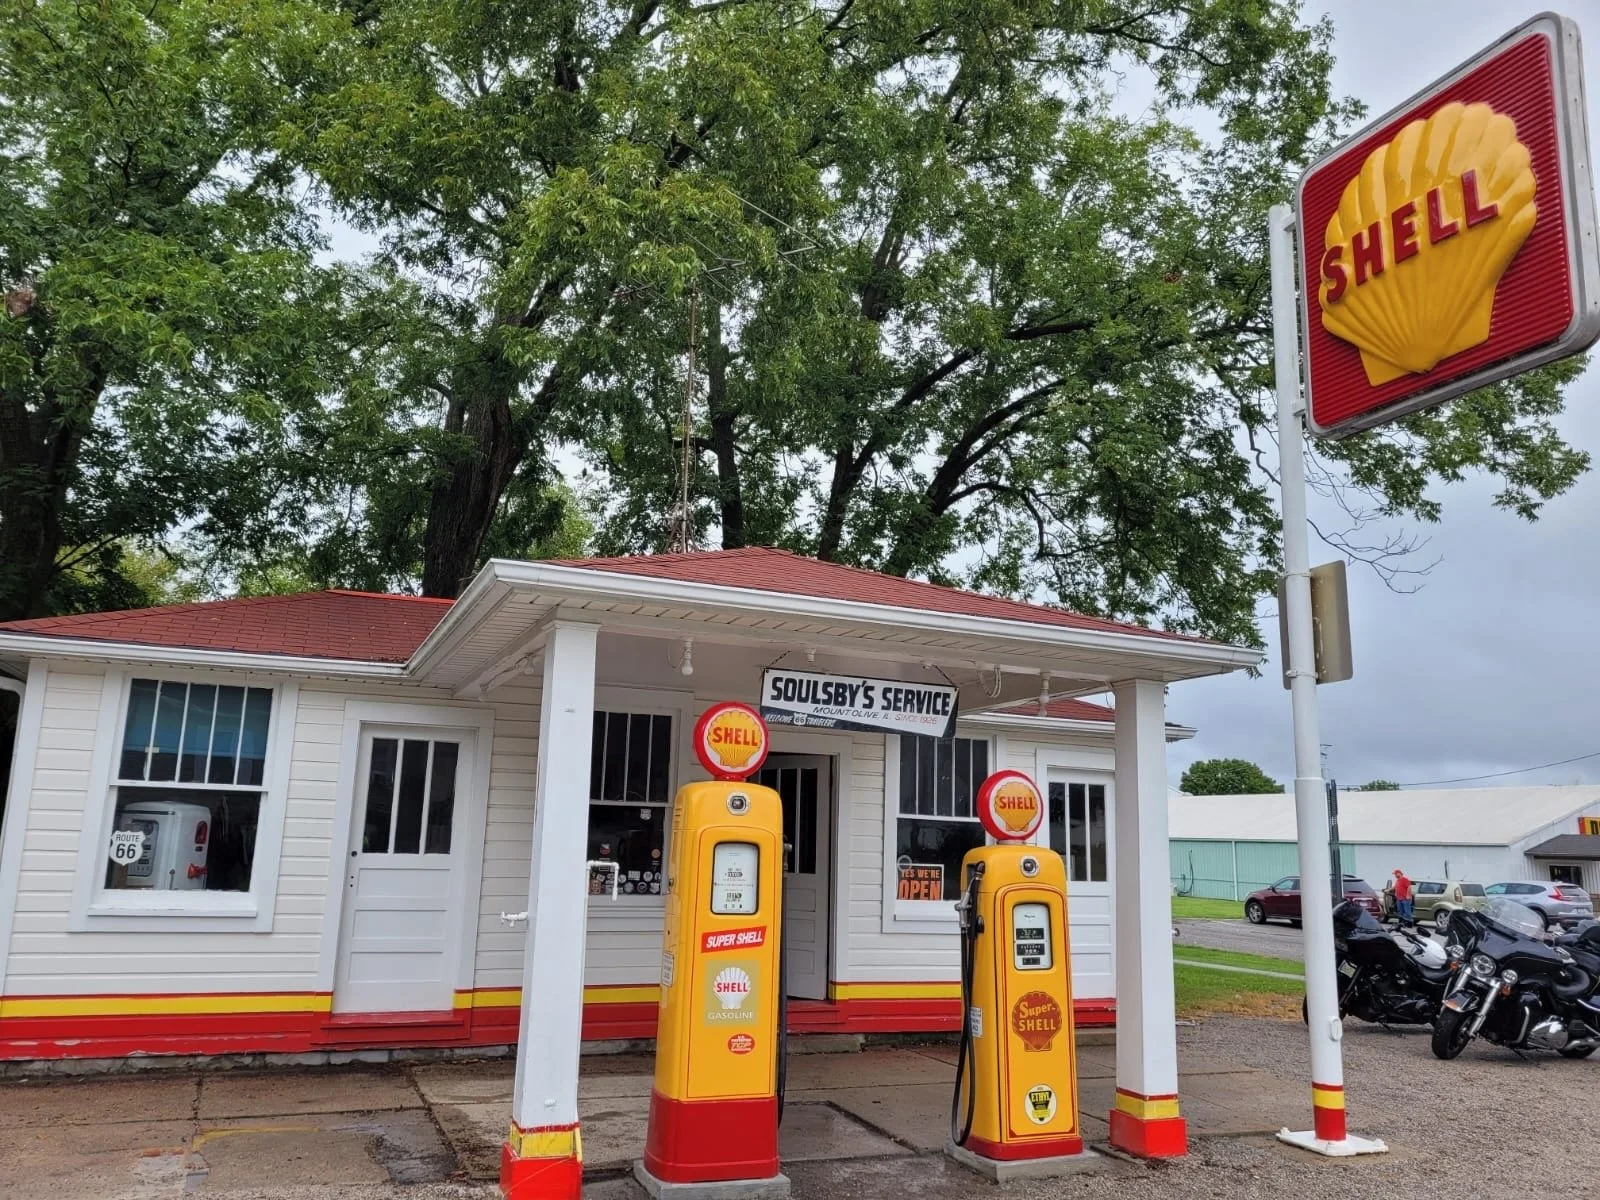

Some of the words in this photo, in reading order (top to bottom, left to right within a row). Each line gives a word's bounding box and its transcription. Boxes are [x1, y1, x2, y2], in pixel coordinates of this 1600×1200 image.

[1322, 168, 1499, 303] SHELL
[770, 676, 875, 709] SOULSBY'S
[881, 687, 950, 716] SERVICE
[812, 706, 852, 716] MOUNT
[895, 713, 917, 722] SINCE
[712, 726, 758, 747] SHELL
[999, 796, 1035, 811] SHELL
[116, 834, 140, 842] ROUTE
[116, 844, 136, 859] 66
[902, 869, 914, 878] YES
[918, 869, 940, 878] WE'RE
[898, 880, 941, 900] OPEN
[706, 934, 736, 949] SUPER
[736, 931, 763, 945] SHELL
[716, 982, 748, 993] SHELL
[708, 1011, 753, 1020] GASOLINE
[1019, 1018, 1056, 1031] SHELL
[1031, 1092, 1050, 1102] ETHYL
